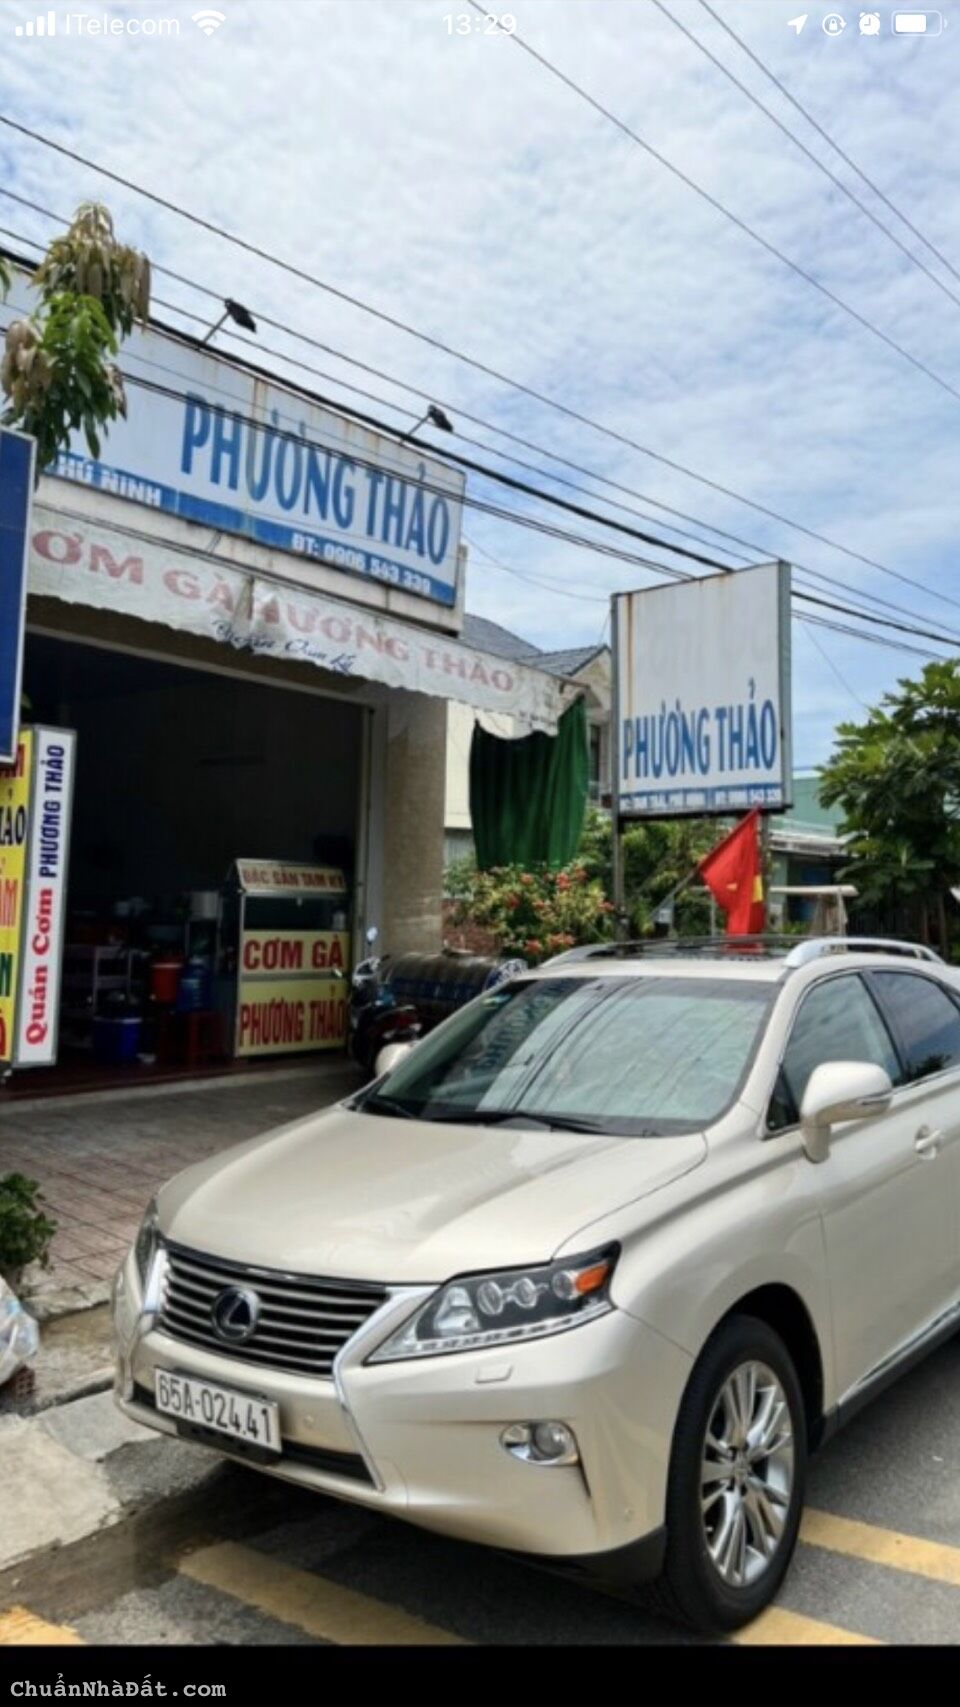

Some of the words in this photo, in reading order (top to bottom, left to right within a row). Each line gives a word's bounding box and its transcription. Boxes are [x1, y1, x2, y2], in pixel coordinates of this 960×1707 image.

[180, 391, 356, 530] PHƯƠNG
[365, 461, 450, 566] THẢO
[622, 697, 711, 780] PHƯƠNG
[715, 676, 777, 771] THẢO
[40, 744, 65, 793] THẢO
[39, 800, 62, 878] PHƯƠNG
[32, 888, 54, 956] Cơm
[243, 936, 304, 970] CƠM
[311, 933, 344, 969] GÀ
[25, 965, 49, 1045] Quán
[239, 996, 304, 1047] PHƯƠNG
[309, 983, 348, 1041] THẢO
[158, 1373, 272, 1444] 65A-024.41
